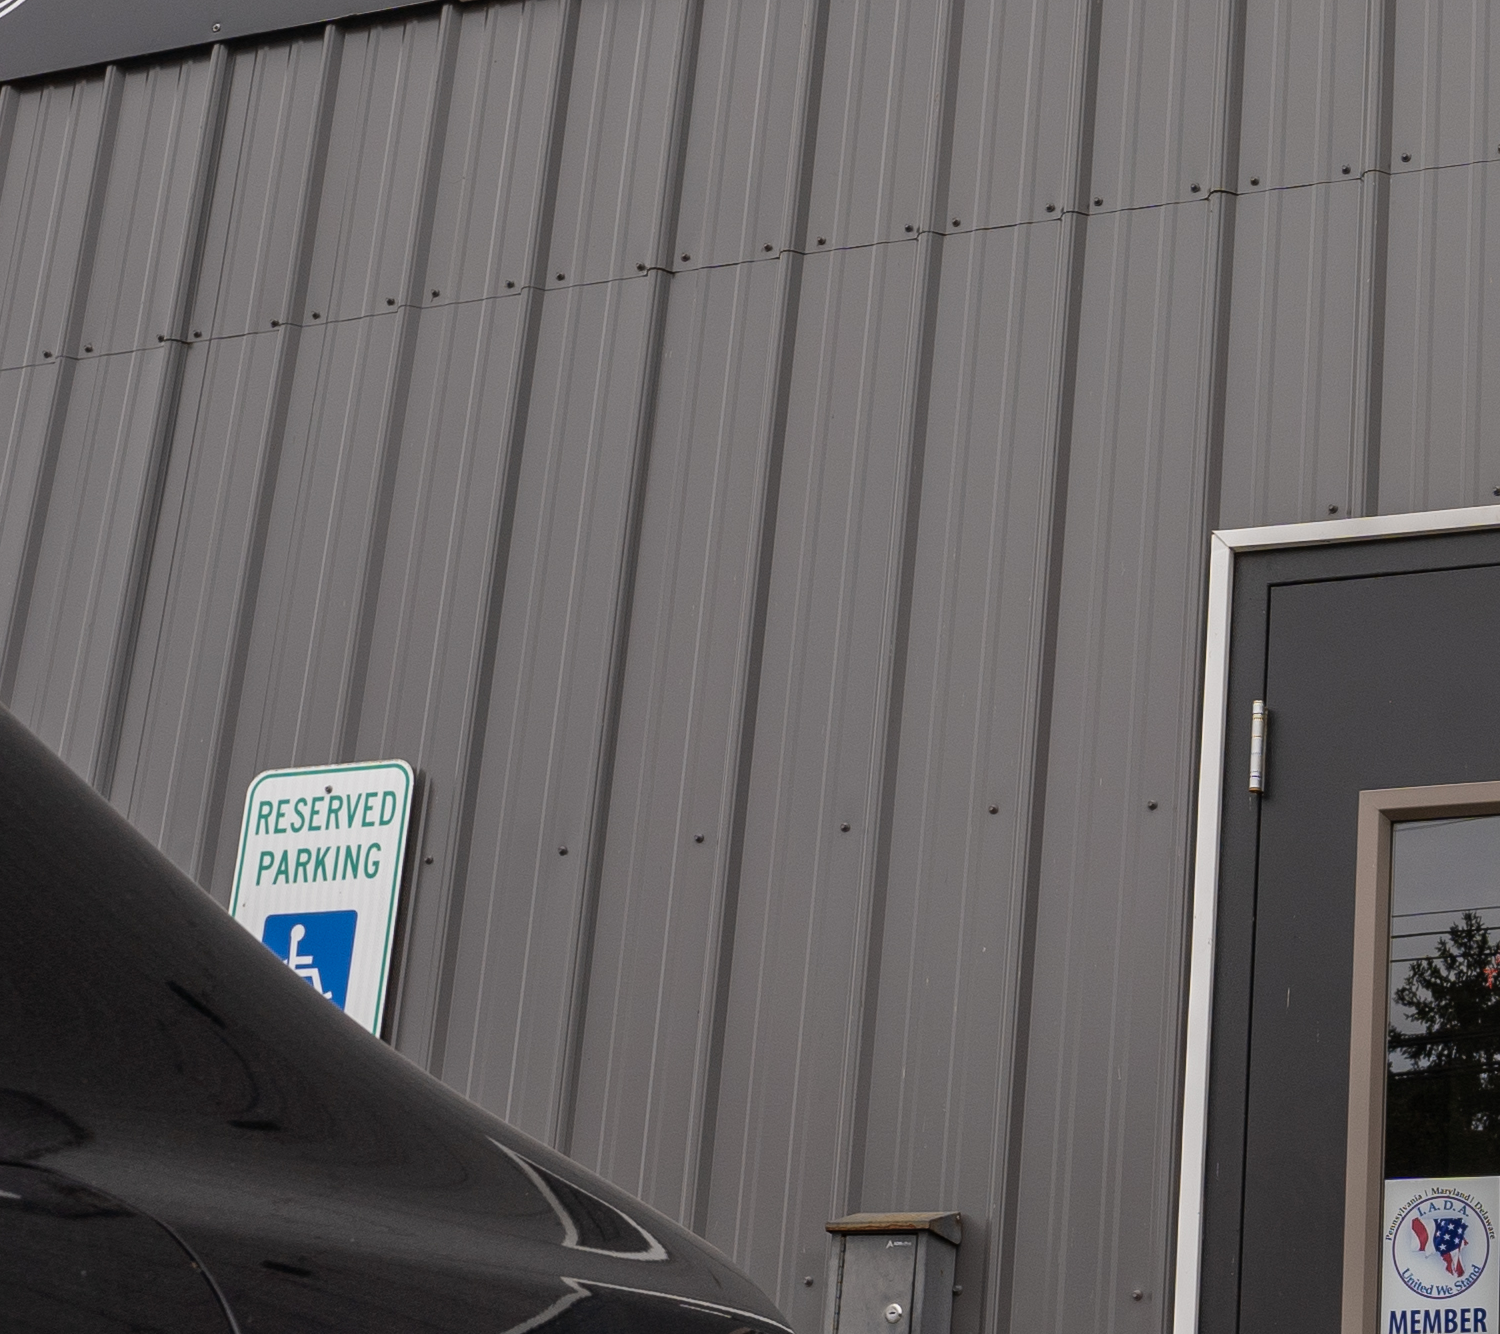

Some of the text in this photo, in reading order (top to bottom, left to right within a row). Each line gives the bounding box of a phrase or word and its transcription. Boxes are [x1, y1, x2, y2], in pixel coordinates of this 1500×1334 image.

[255, 790, 397, 835] RESERVED
[255, 842, 382, 886] PARKING
[1385, 1187, 1496, 1241] Pennsylvania Maryland Delaware
[1402, 1264, 1482, 1296] United We Stand
